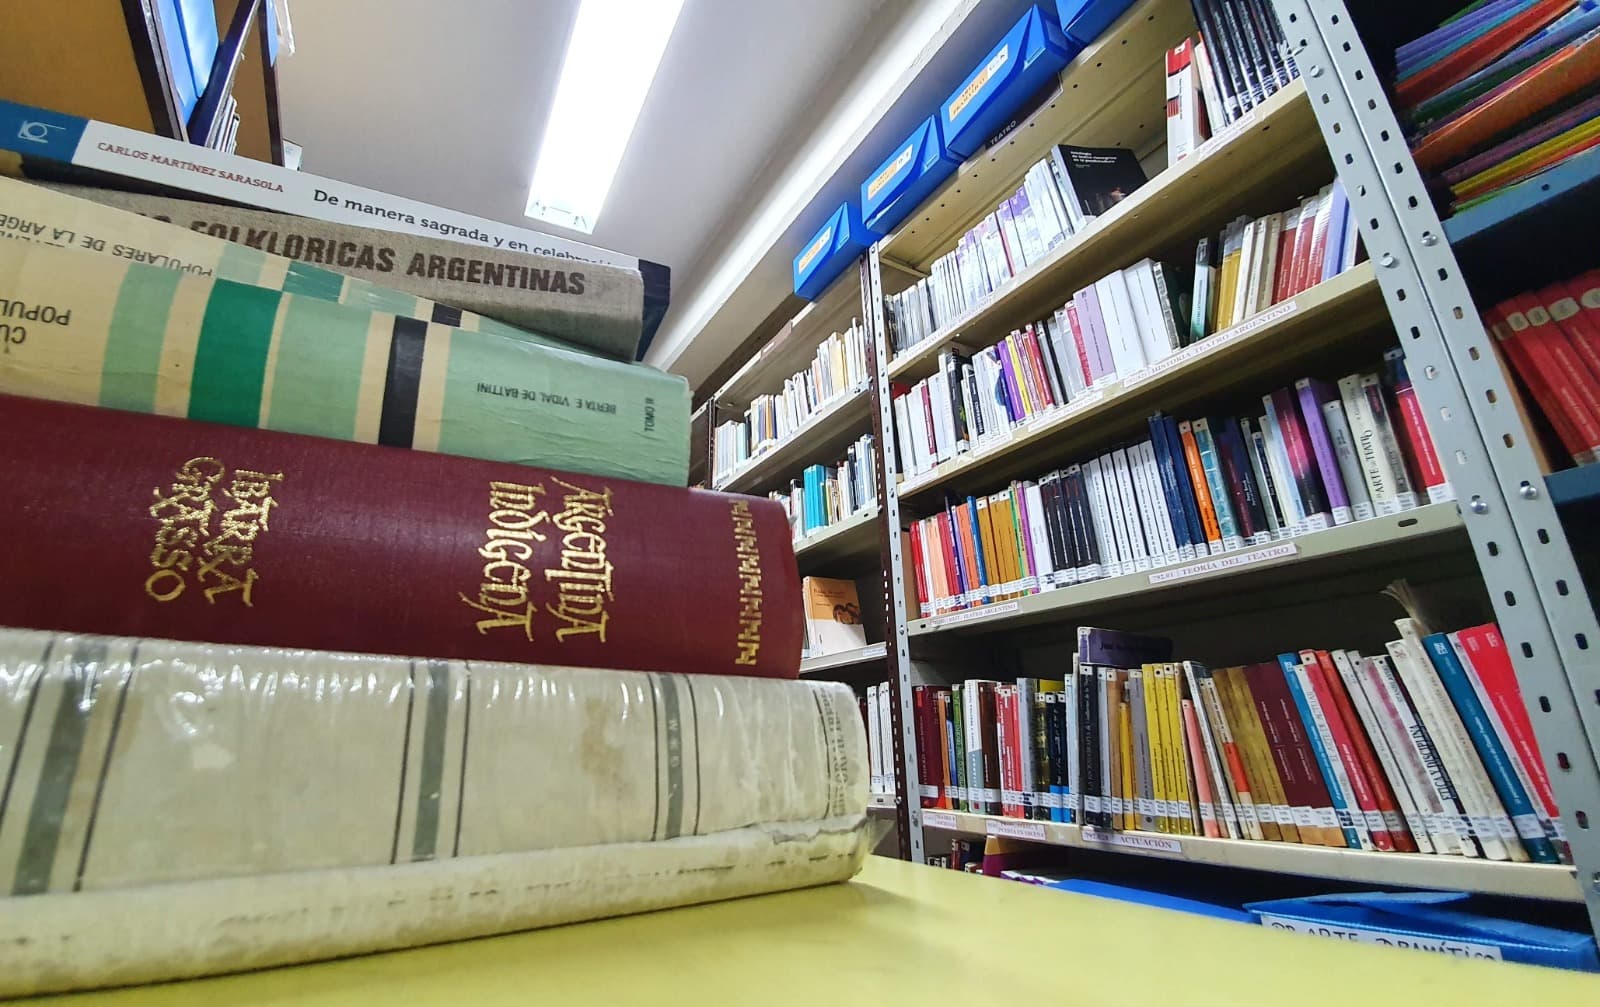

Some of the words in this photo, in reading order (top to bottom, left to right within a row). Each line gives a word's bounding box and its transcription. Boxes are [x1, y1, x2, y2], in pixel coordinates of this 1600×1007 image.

[990, 120, 1017, 145] TEATRO
[97, 142, 149, 160] CARLOS
[150, 153, 217, 177] MARTÍNEZ
[218, 170, 285, 193] SARASOLA
[313, 189, 339, 205] De
[344, 199, 416, 225] manera
[420, 217, 489, 243] sagrada
[493, 234, 505, 248] y
[508, 239, 529, 253] en
[53, 227, 76, 244] LA
[80, 235, 106, 252] DE
[406, 252, 585, 295] ARGENTINAS
[1150, 351, 1193, 374] HISTORIA
[1195, 334, 1231, 353] TEATRO
[1233, 304, 1293, 336] ARGENTINO
[477, 382, 519, 399] BATTINI
[521, 389, 536, 401] DE
[542, 391, 570, 407] VIDAL
[585, 399, 617, 414] BERTA
[644, 406, 656, 432] TOMO
[1221, 557, 1243, 568] DEL
[1247, 546, 1290, 562] TEATRO
[1120, 836, 1172, 849] ACTUACIÓN
